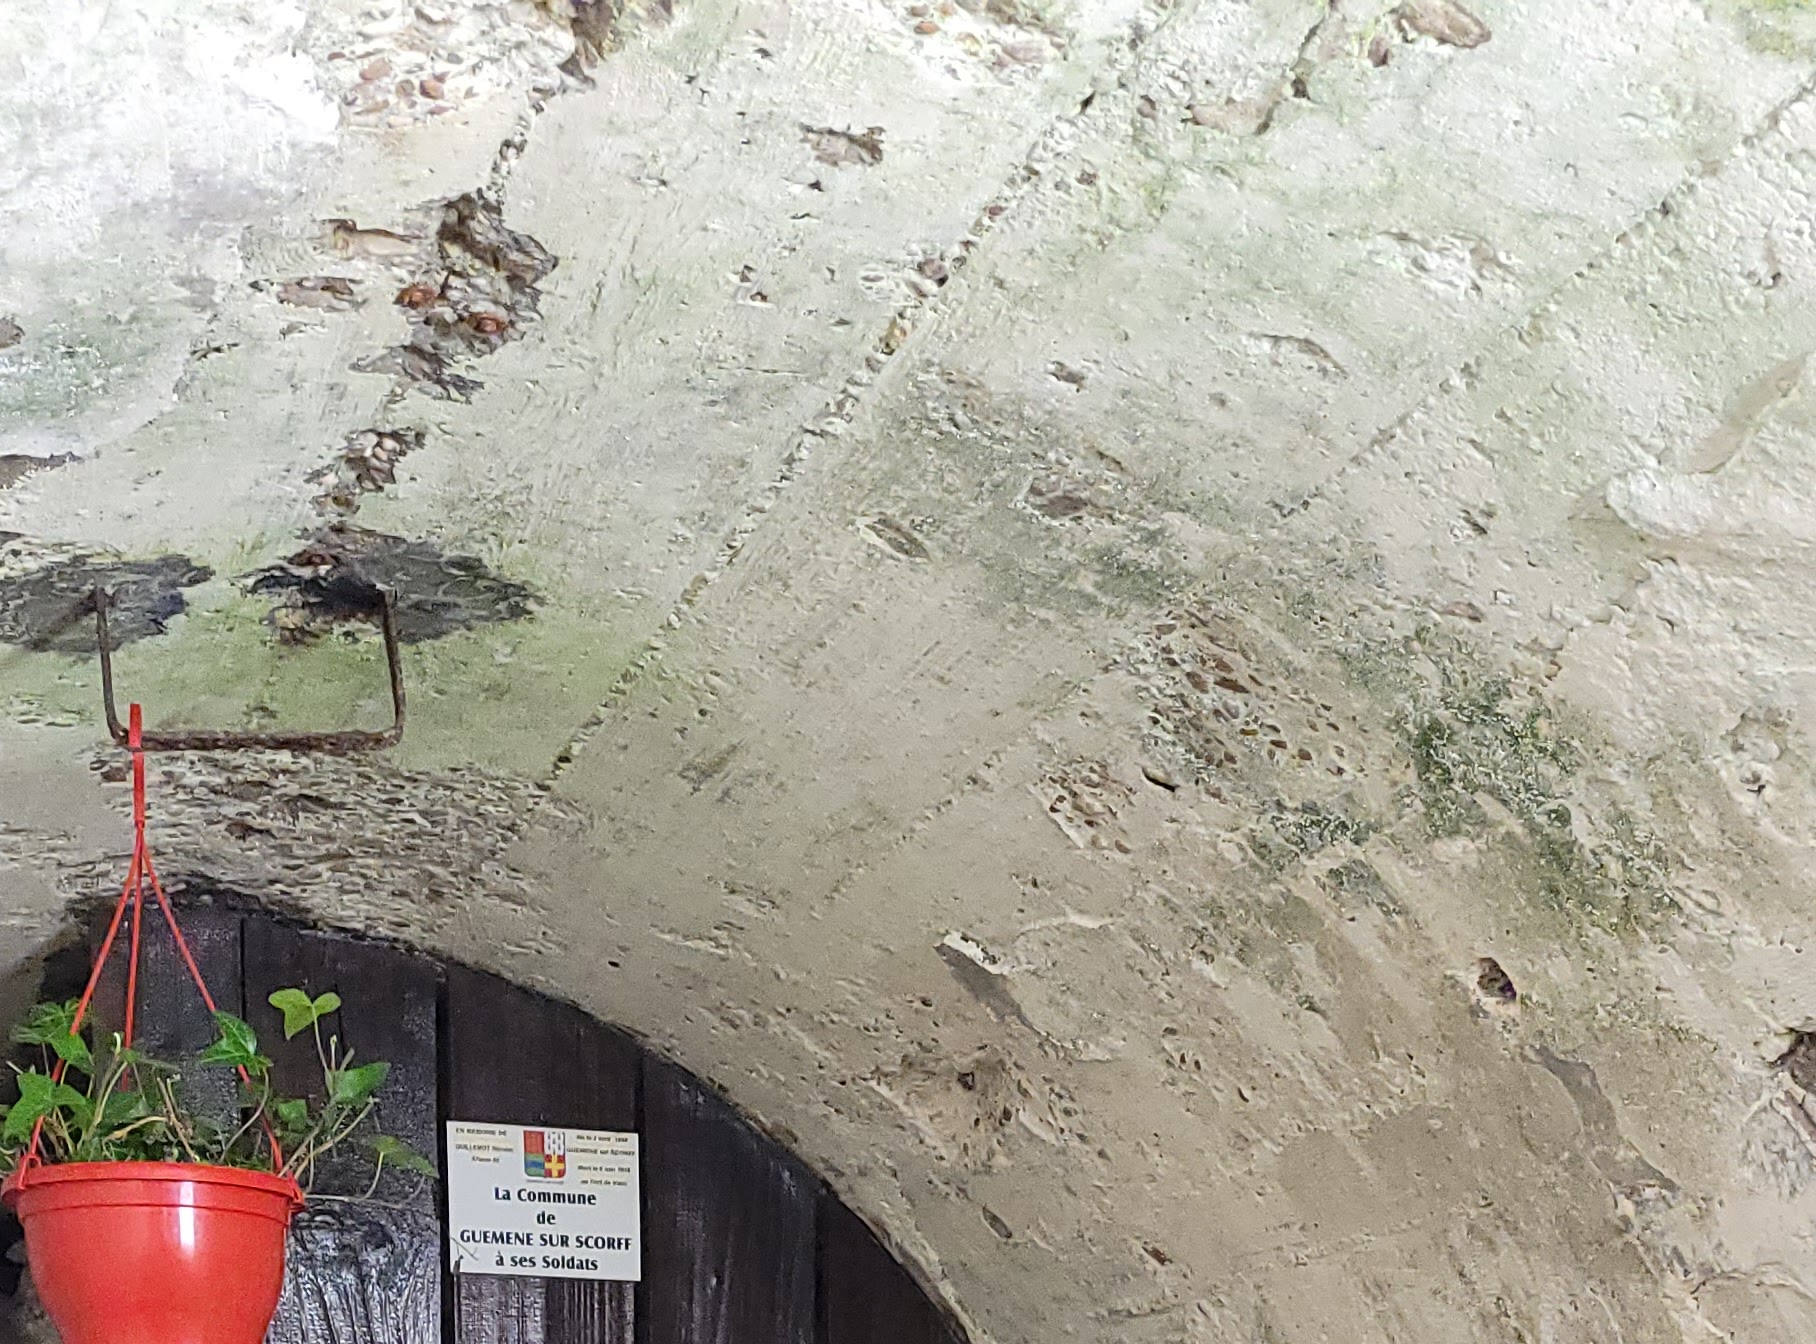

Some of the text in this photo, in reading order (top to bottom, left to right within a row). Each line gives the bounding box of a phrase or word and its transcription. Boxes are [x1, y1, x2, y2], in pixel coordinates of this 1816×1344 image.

[494, 1187, 597, 1206] La Commune
[536, 1210, 556, 1225] de
[460, 1229, 632, 1251] GUEMENE SUR SCORFF
[495, 1251, 599, 1271] à ses Soldats
